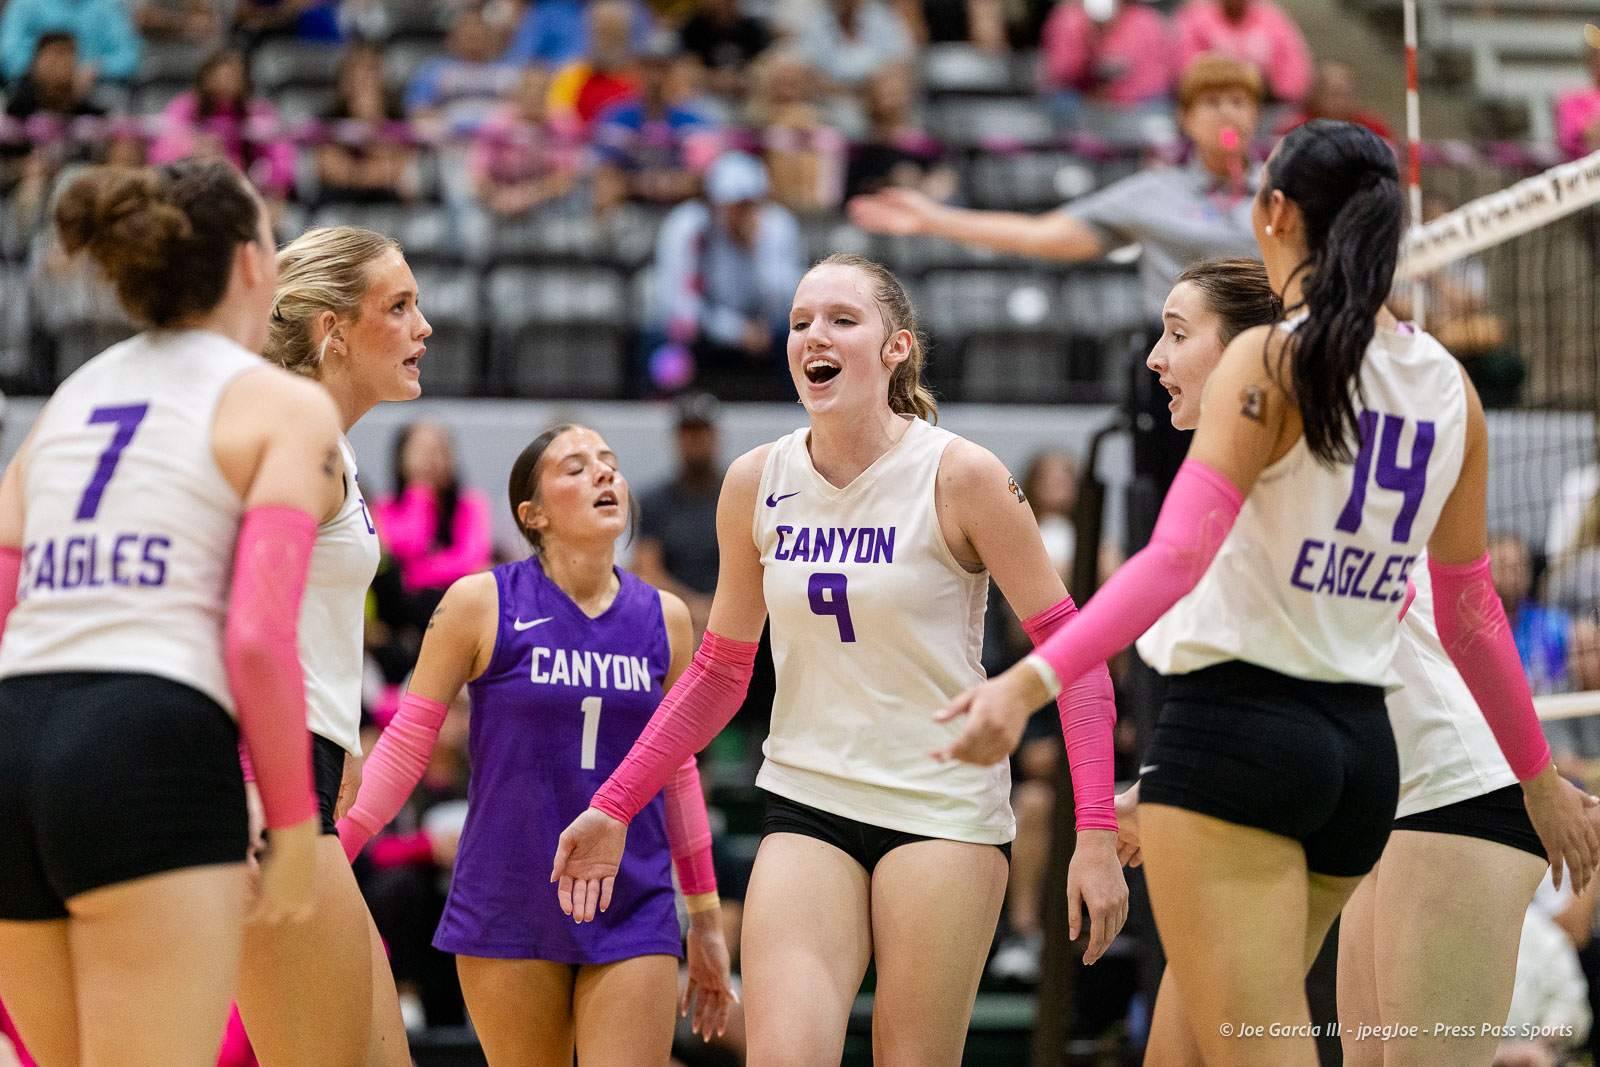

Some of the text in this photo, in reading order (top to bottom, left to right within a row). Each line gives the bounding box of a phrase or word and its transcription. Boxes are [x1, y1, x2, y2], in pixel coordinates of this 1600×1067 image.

[75, 403, 149, 521] 7
[1335, 410, 1435, 543] 14
[775, 525, 896, 564] CANYON
[1291, 539, 1416, 603] EAGLES
[807, 572, 856, 642] 9
[531, 646, 651, 692] CANYON
[581, 696, 602, 770] 1
